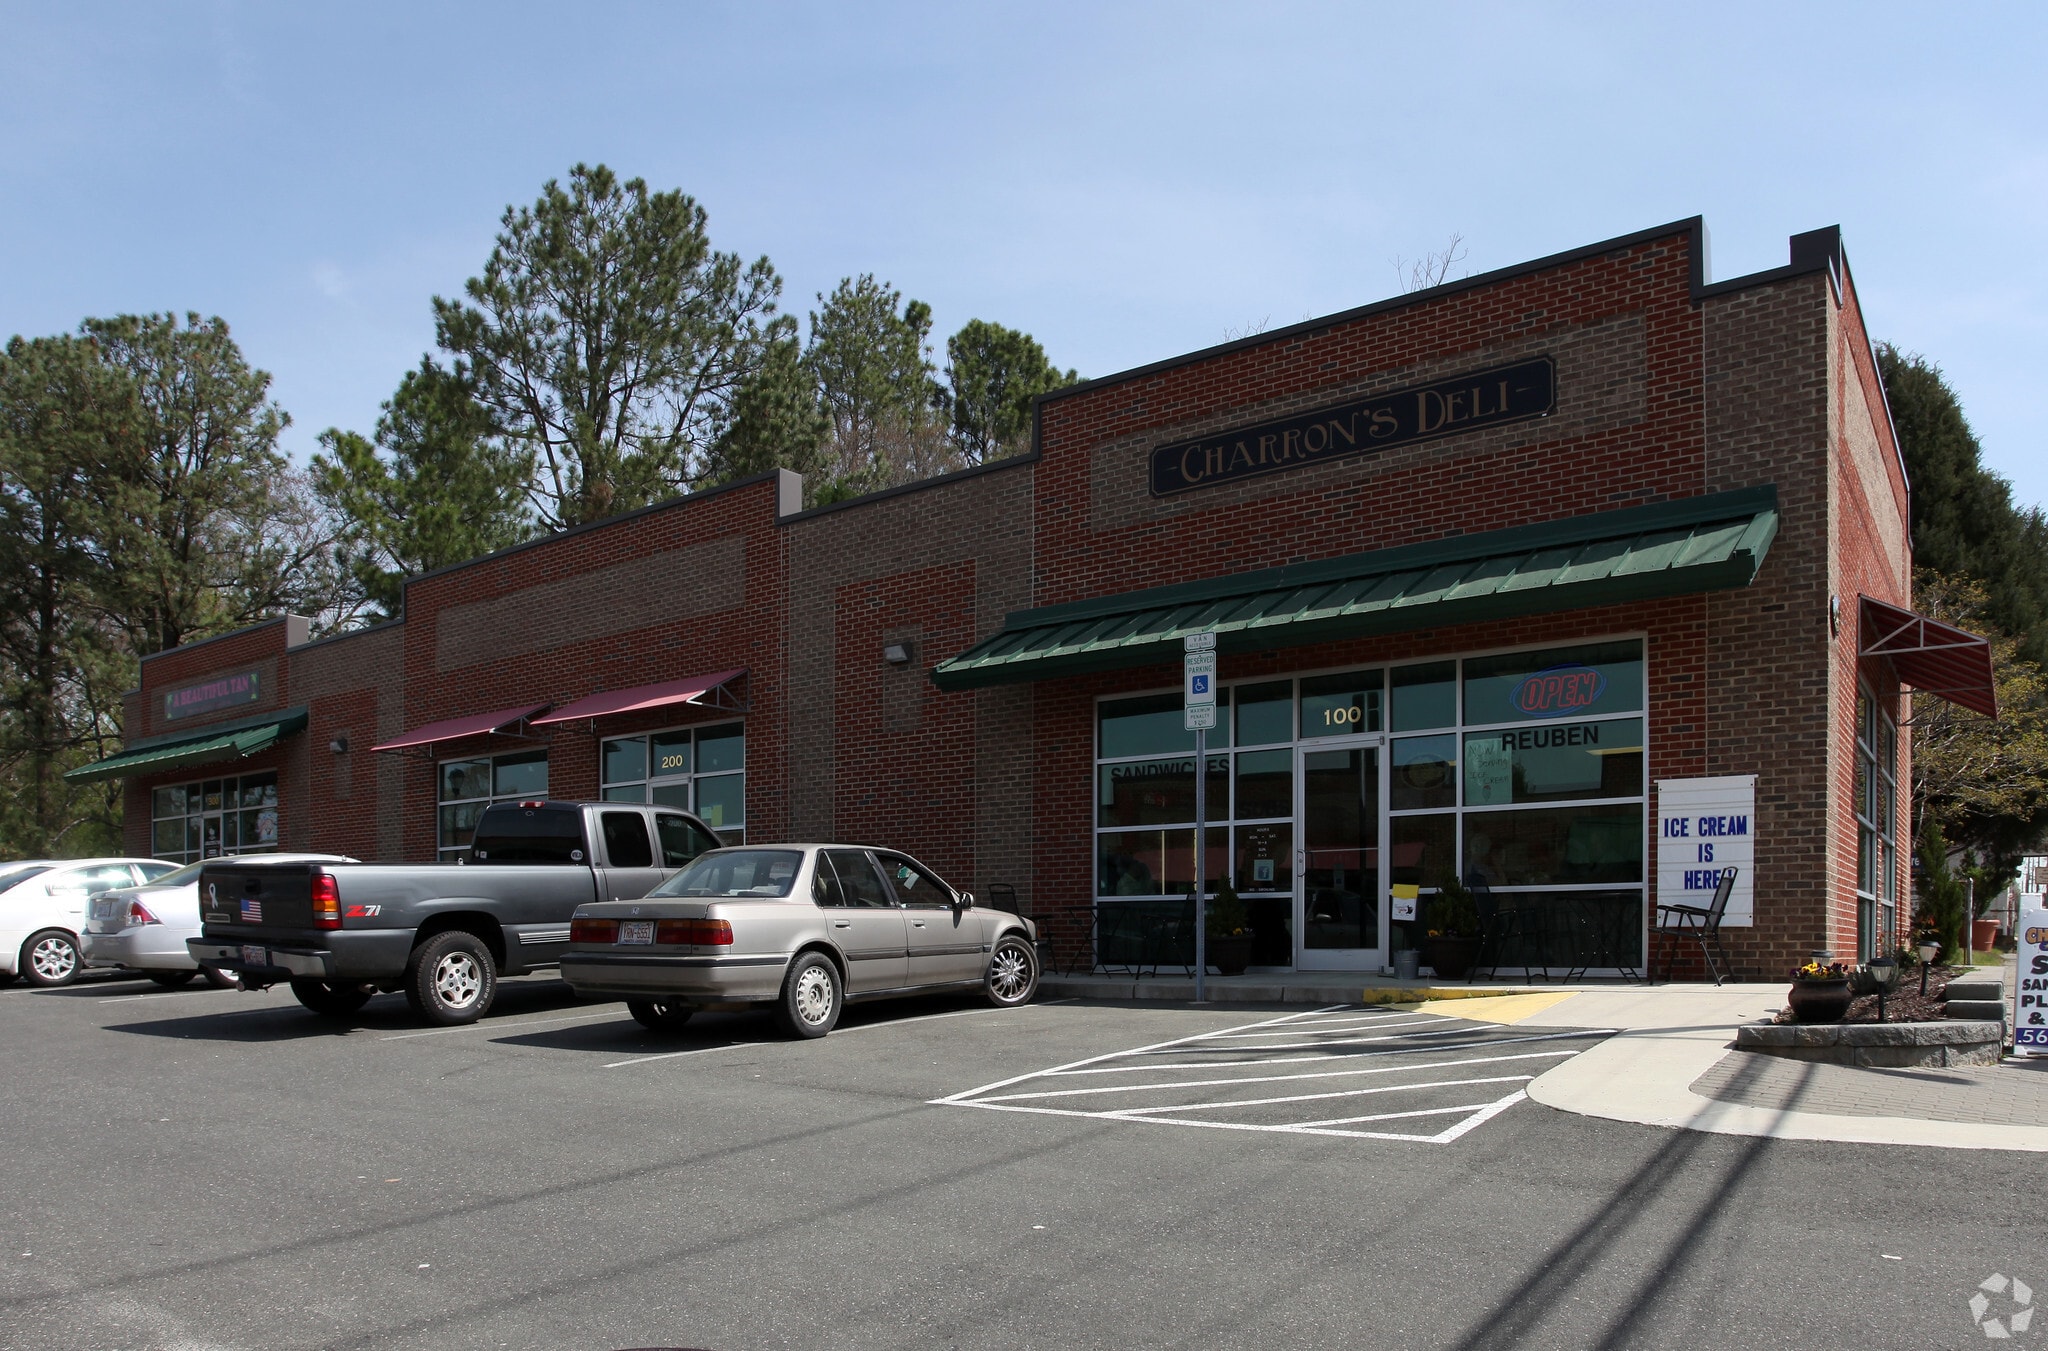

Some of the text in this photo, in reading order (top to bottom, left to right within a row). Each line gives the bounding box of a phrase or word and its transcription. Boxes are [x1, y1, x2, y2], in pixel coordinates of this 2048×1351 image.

[1180, 380, 1509, 483] CHARRON'S DELI
[1187, 655, 1213, 665] RESERVED
[1188, 665, 1212, 674] PARKING
[173, 693, 180, 708] A
[180, 681, 229, 705] BEAUTIFUL
[230, 676, 249, 694] TAN
[1521, 672, 1596, 711] OPEN
[1324, 706, 1362, 726] 100
[1502, 726, 1598, 751] REUBEN
[661, 754, 683, 769] 200
[1111, 759, 1229, 783] SANDWICES
[1664, 815, 1747, 838] ICE CREAM
[1698, 843, 1714, 863] IS
[345, 904, 382, 917] Z71
[2027, 1011, 2046, 1025] &
